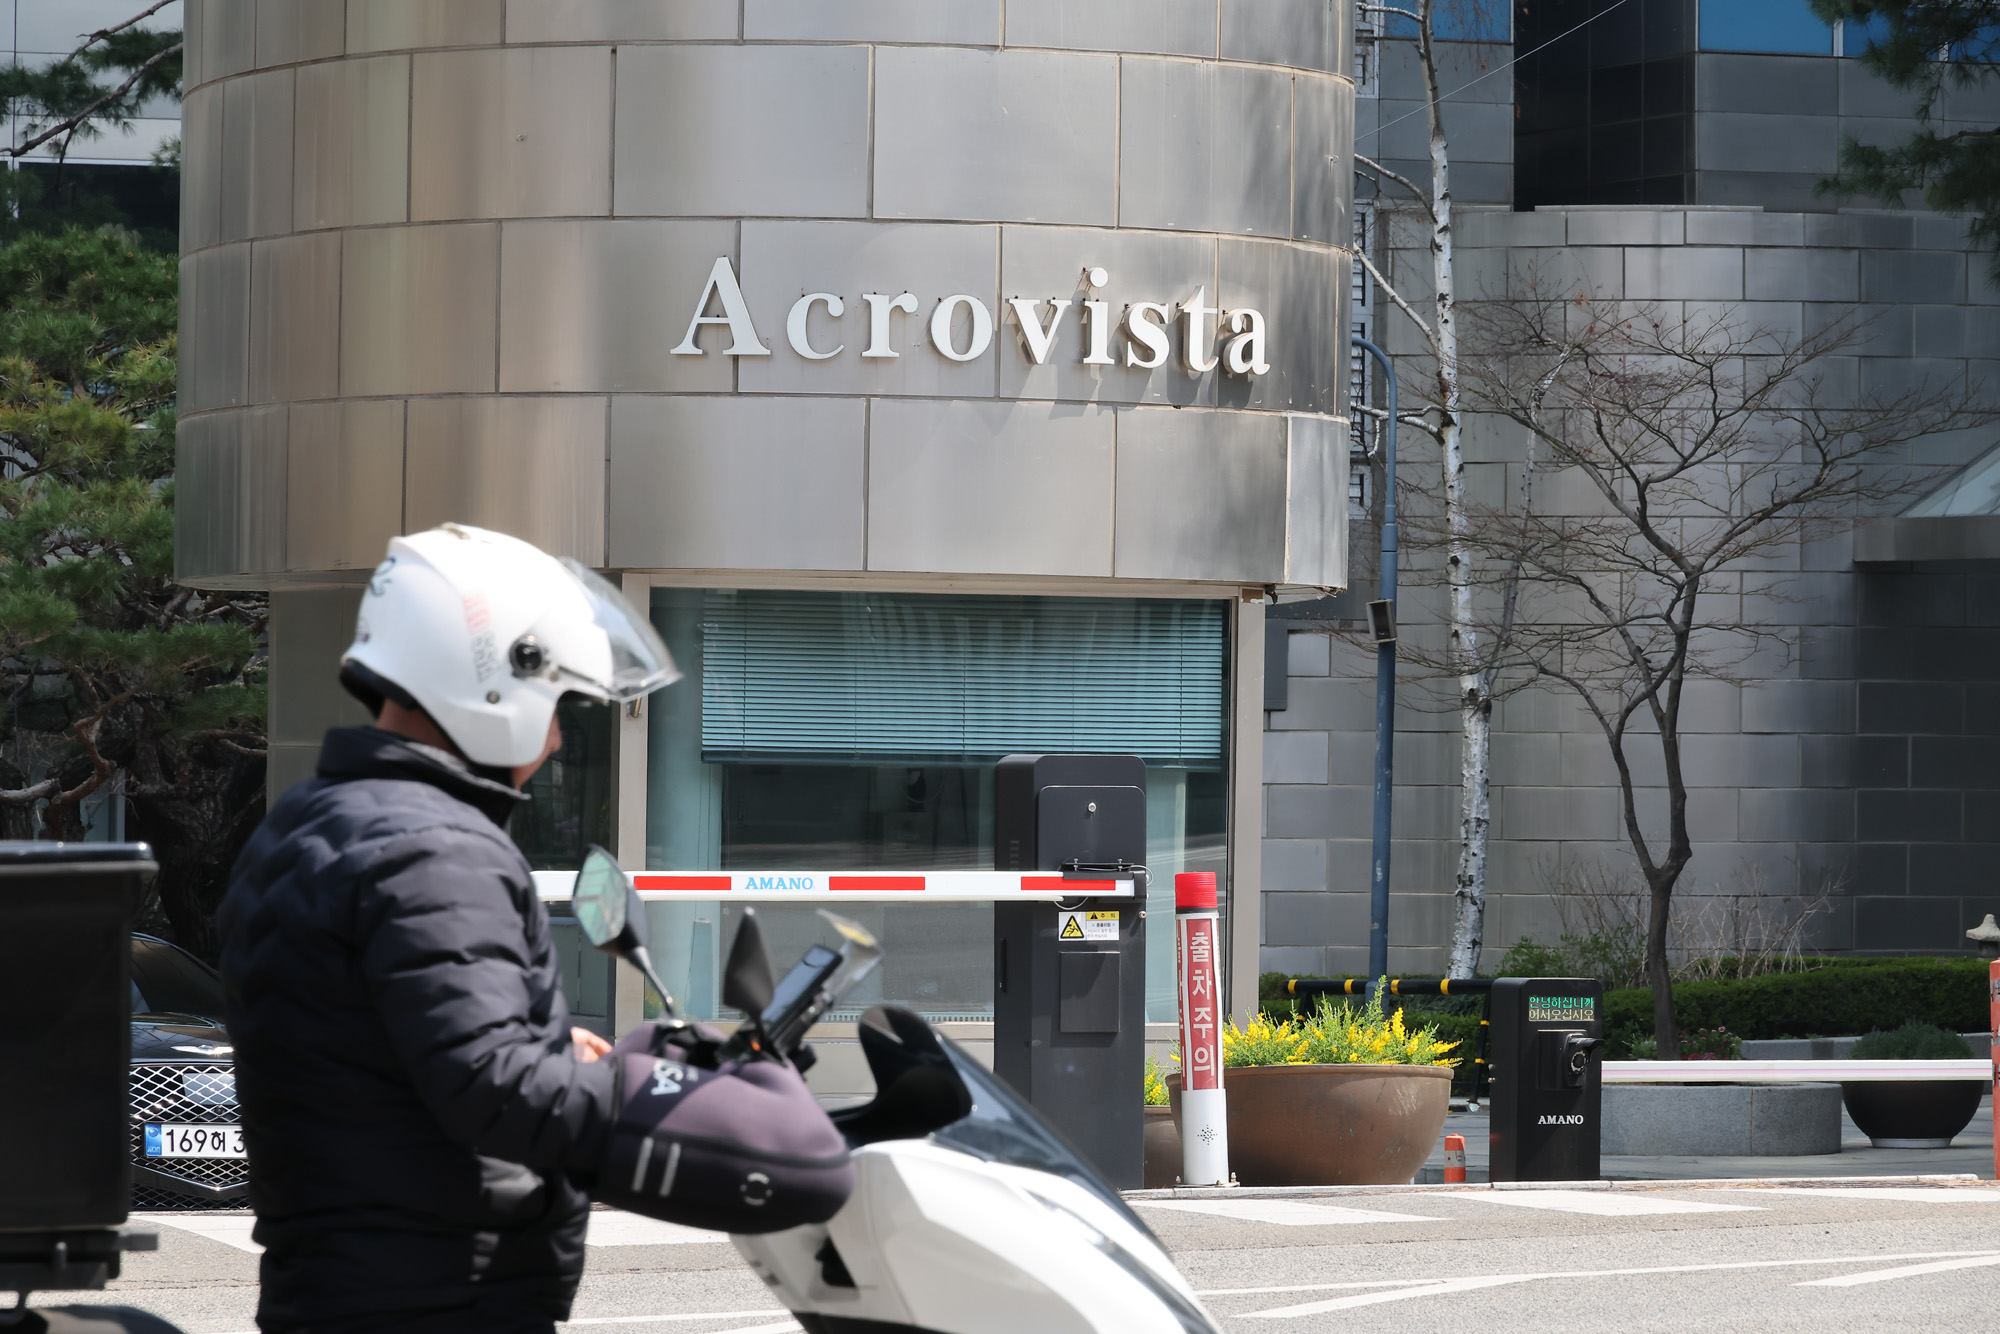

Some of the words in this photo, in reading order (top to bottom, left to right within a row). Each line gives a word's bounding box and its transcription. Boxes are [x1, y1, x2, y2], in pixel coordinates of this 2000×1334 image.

[669, 256, 1271, 376] Acrovista
[744, 876, 814, 890] AMANO
[1529, 996, 1594, 1009] 안녕하십니까
[1529, 1009, 1594, 1020] 어서오십시오
[1537, 1114, 1584, 1125] AMANO
